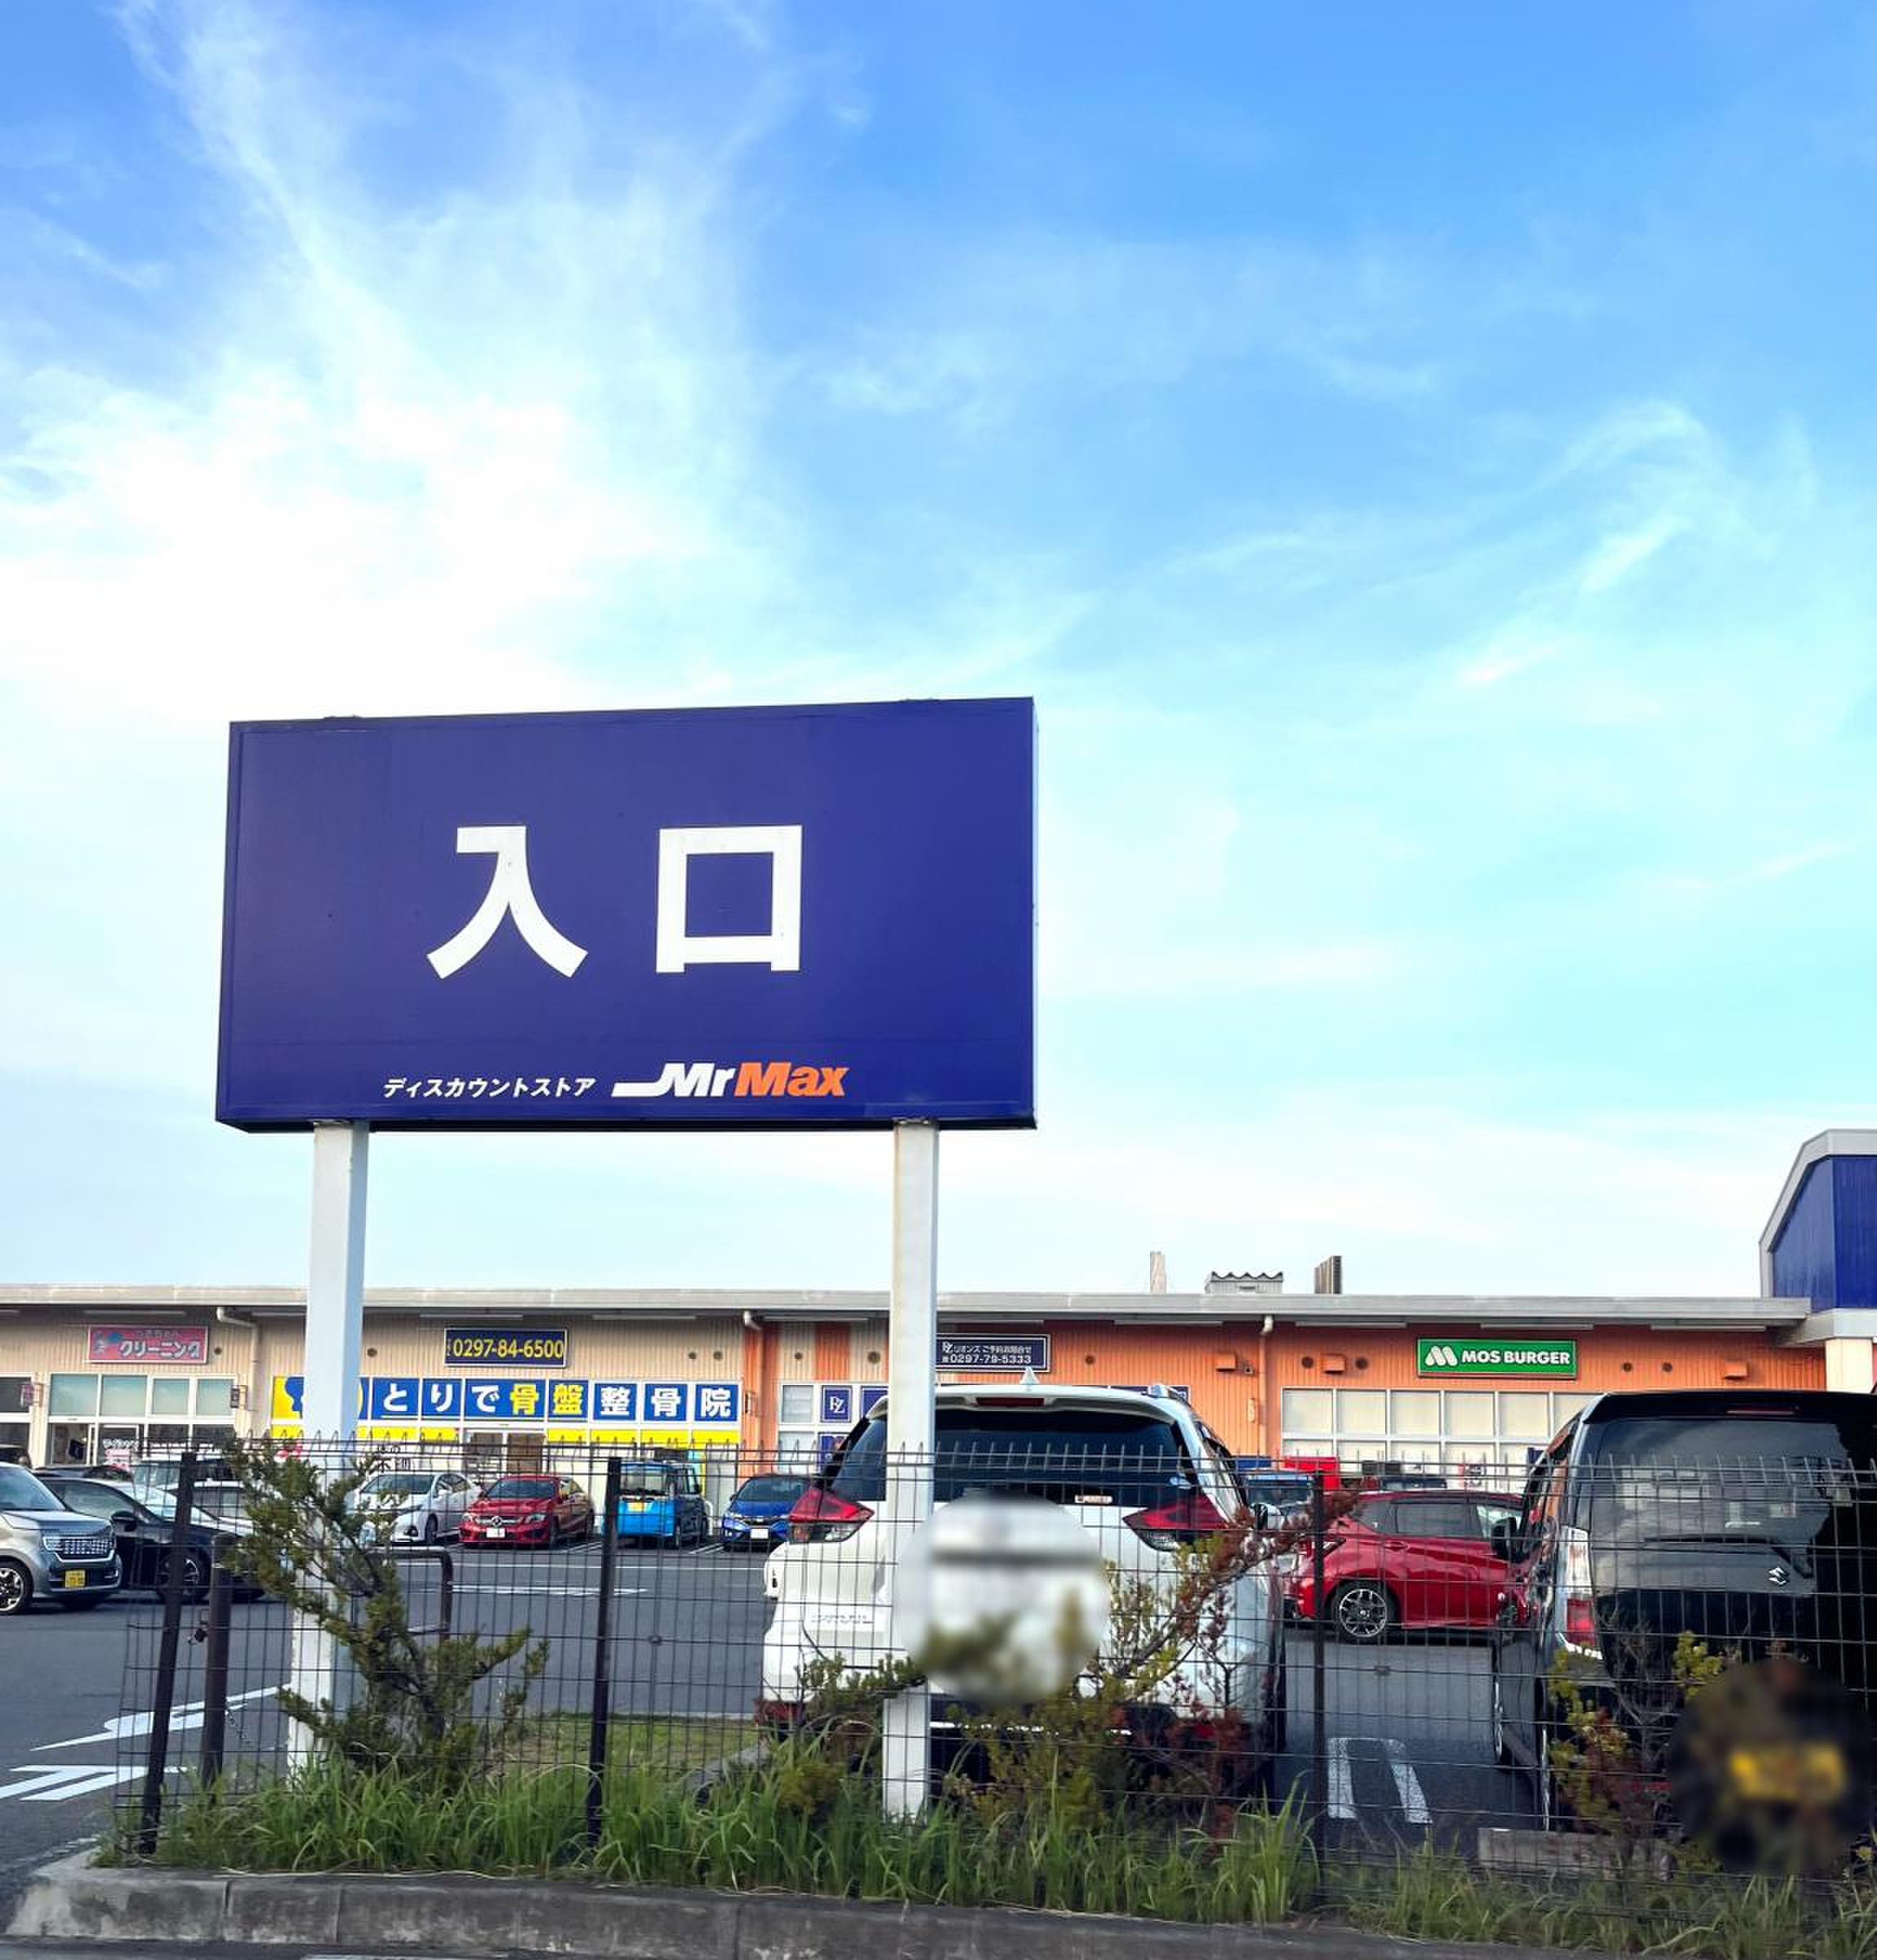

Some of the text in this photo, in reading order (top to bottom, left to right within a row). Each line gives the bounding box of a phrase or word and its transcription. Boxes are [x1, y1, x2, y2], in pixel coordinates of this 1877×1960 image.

[427, 824, 802, 979] 入口
[383, 1077, 596, 1098] ディスカウントストア
[453, 1338, 564, 1358] 0297-84-6500
[1461, 1350, 1571, 1365] MOS BURGER
[382, 1383, 733, 1418] とりで骨盤整骨院
